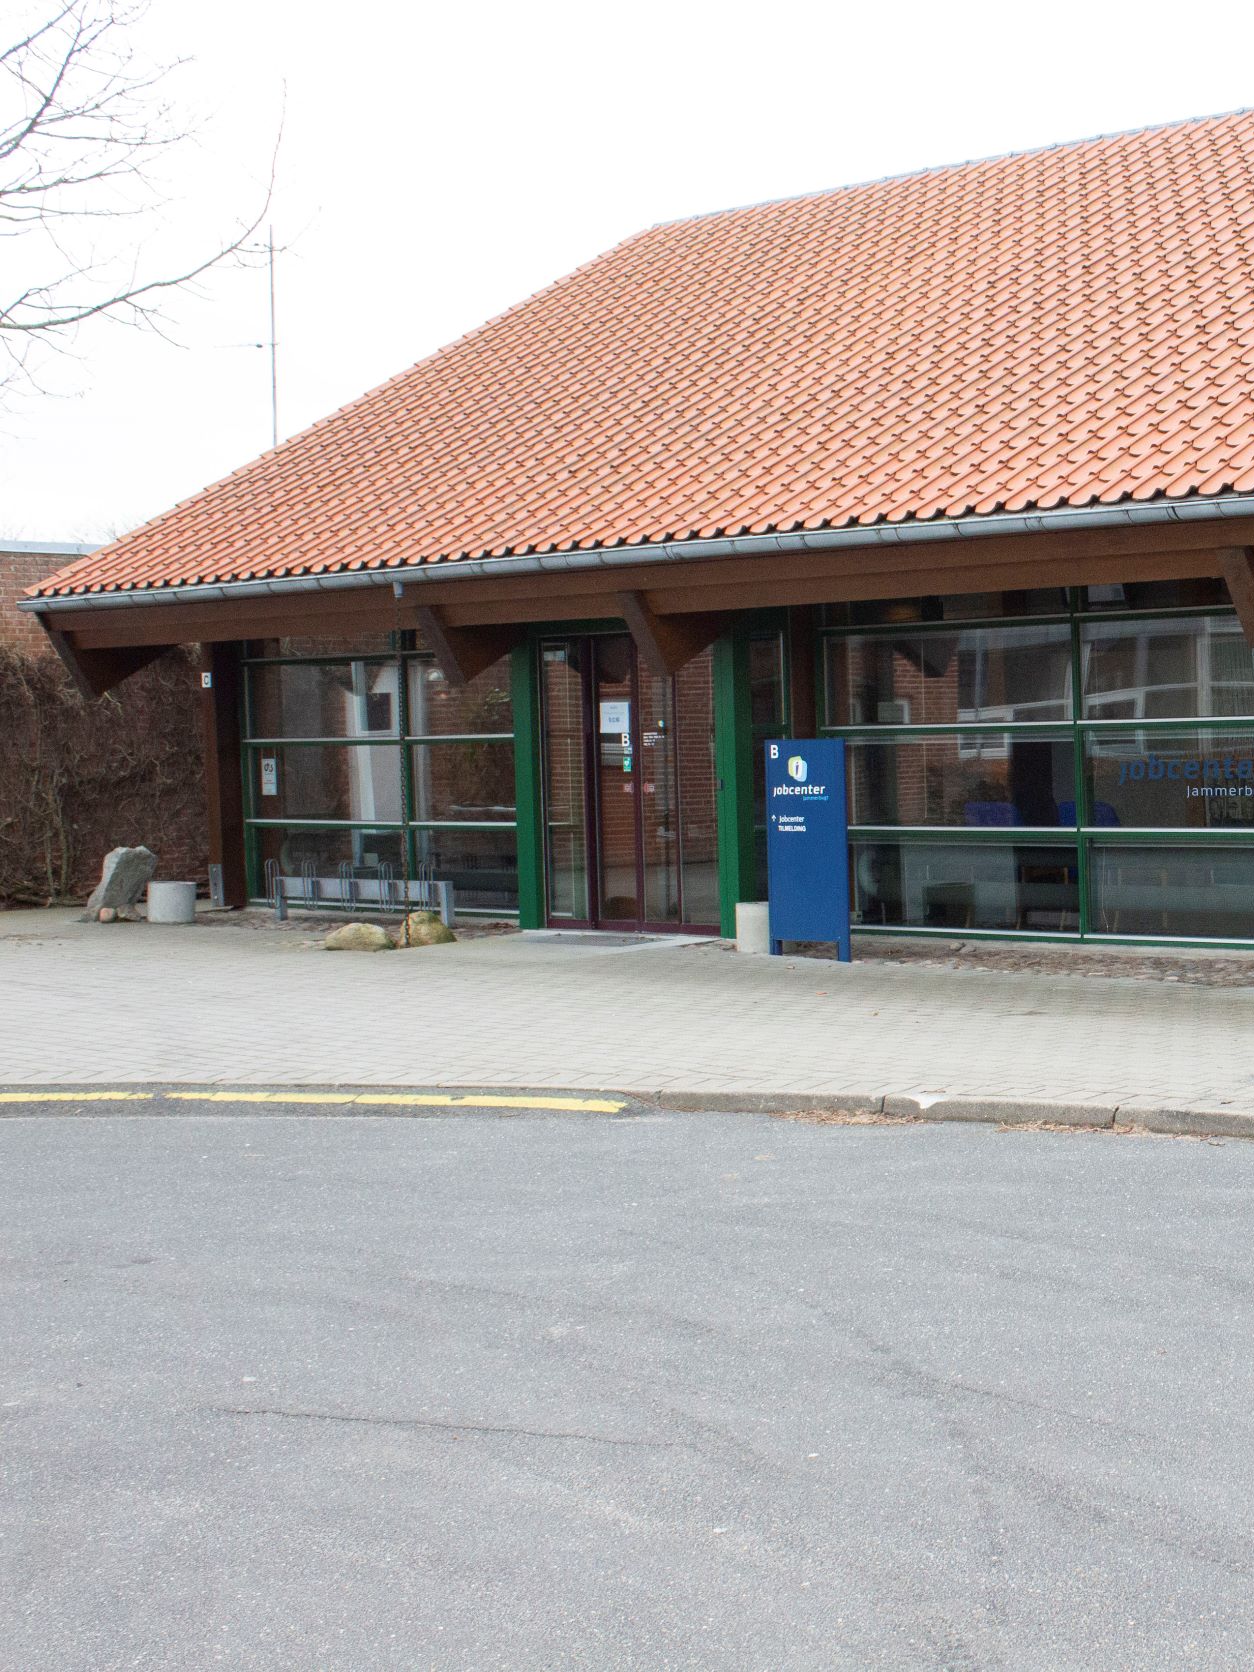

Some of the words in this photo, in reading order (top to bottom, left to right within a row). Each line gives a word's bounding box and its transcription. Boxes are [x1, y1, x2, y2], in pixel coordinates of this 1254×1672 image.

[622, 733, 630, 747] B
[770, 745, 779, 759] B
[773, 784, 825, 797] jobcenter
